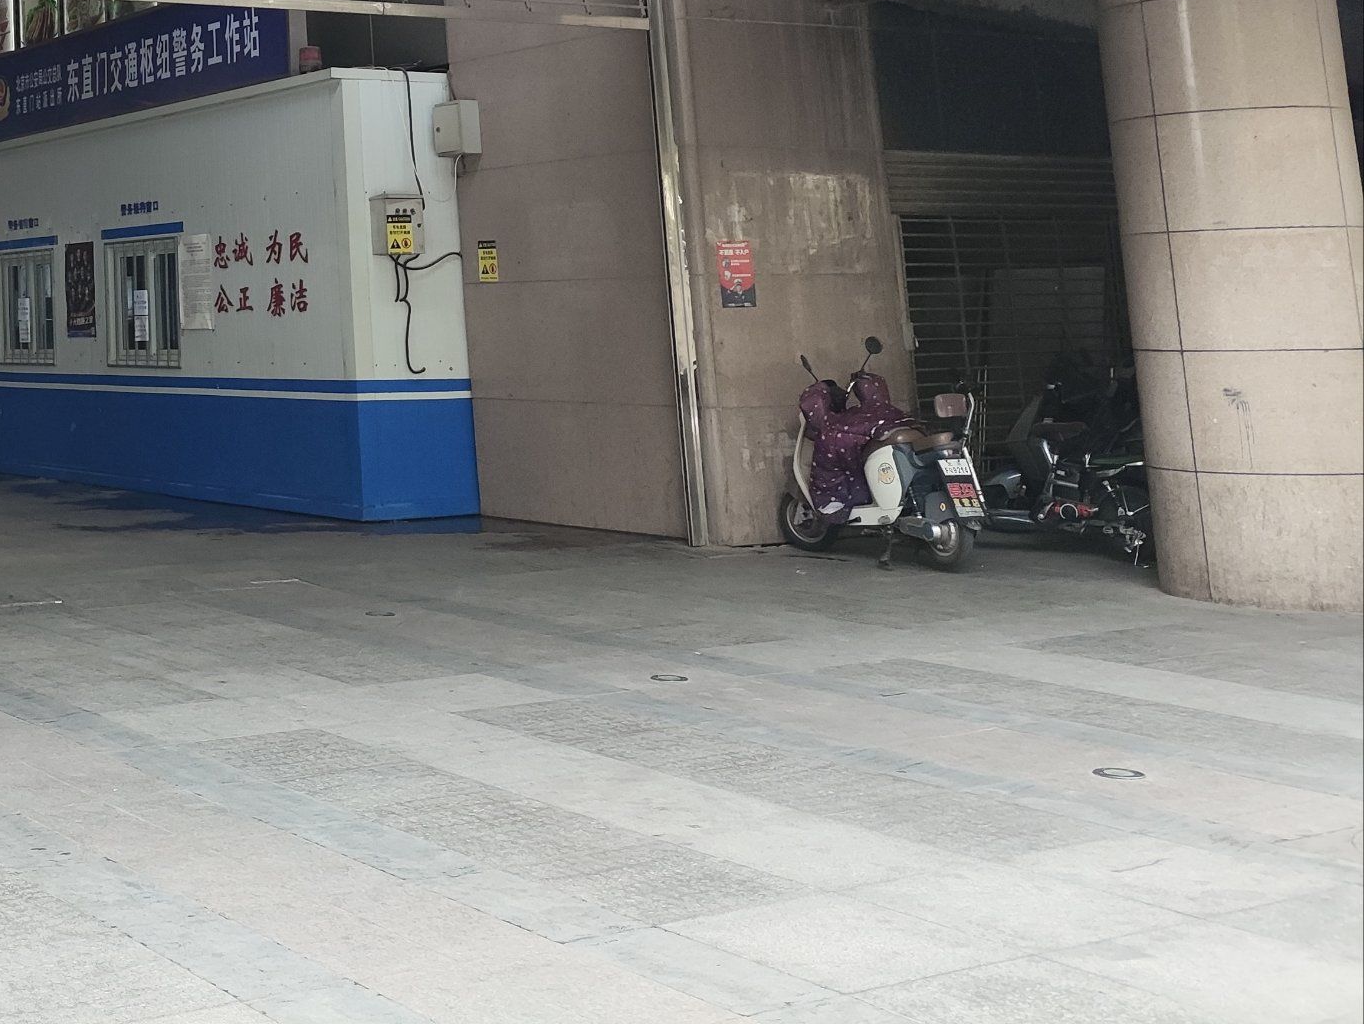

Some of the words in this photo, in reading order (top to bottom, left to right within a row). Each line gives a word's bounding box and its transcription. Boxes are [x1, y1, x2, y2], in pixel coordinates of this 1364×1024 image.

[66, 8, 261, 104] 东直门交通枢纽警务工作站
[214, 231, 254, 269] 忠诚
[265, 228, 309, 265] 为民
[214, 284, 254, 314] 公正
[266, 277, 309, 317] 廉洁
